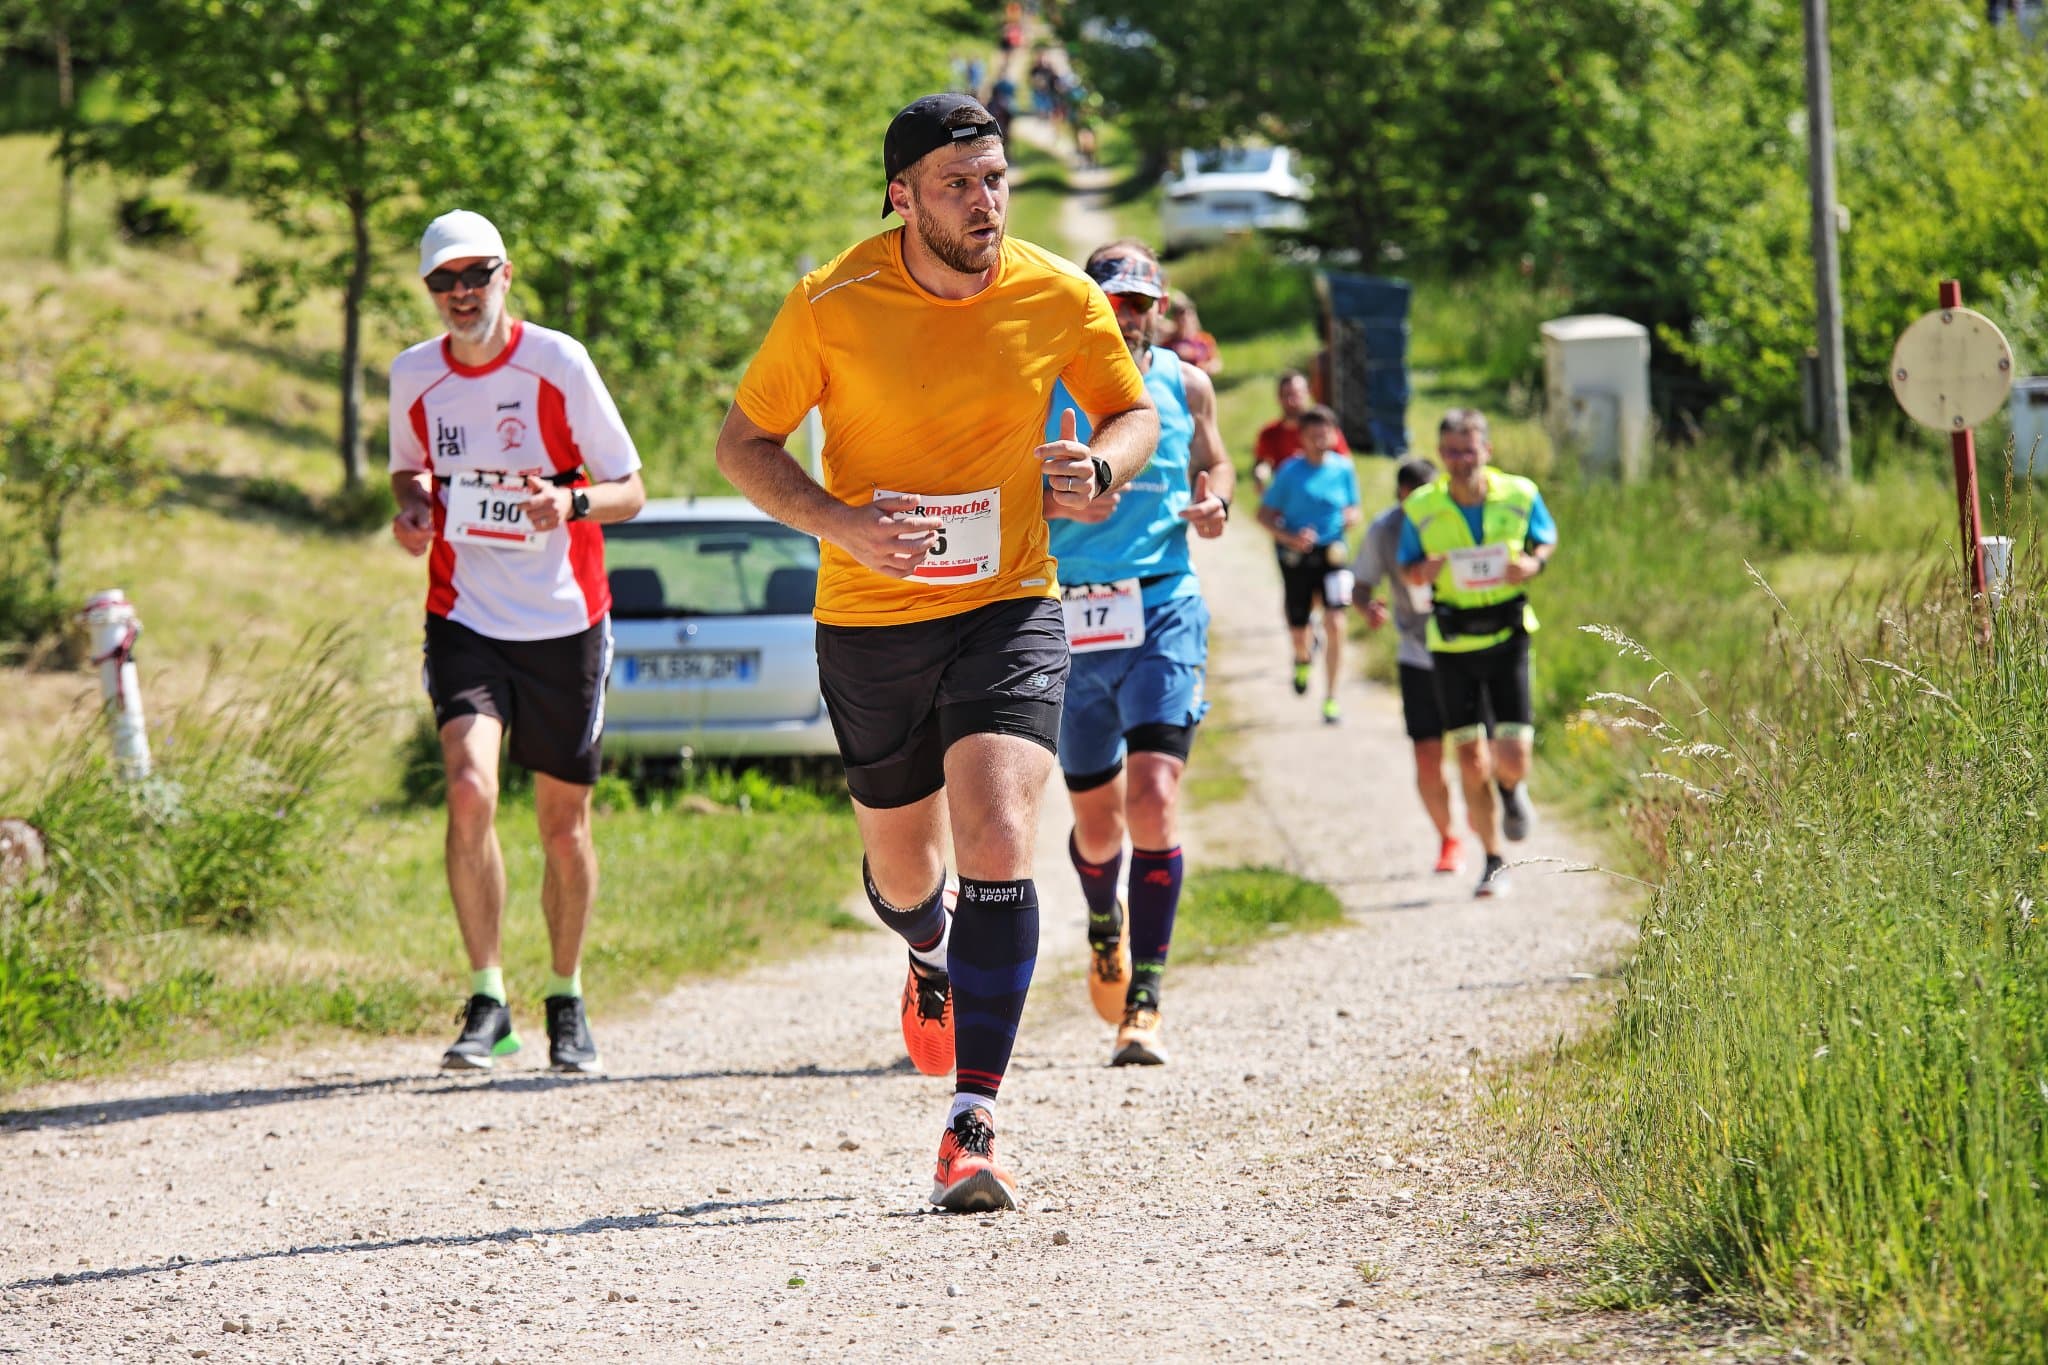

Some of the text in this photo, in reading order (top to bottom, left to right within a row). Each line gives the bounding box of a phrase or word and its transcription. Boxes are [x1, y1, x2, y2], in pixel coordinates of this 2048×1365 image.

[479, 499, 521, 524] 190
[1083, 607, 1109, 627] 17
[979, 887, 1017, 895] THUASNE
[979, 894, 1018, 902] SPORT
